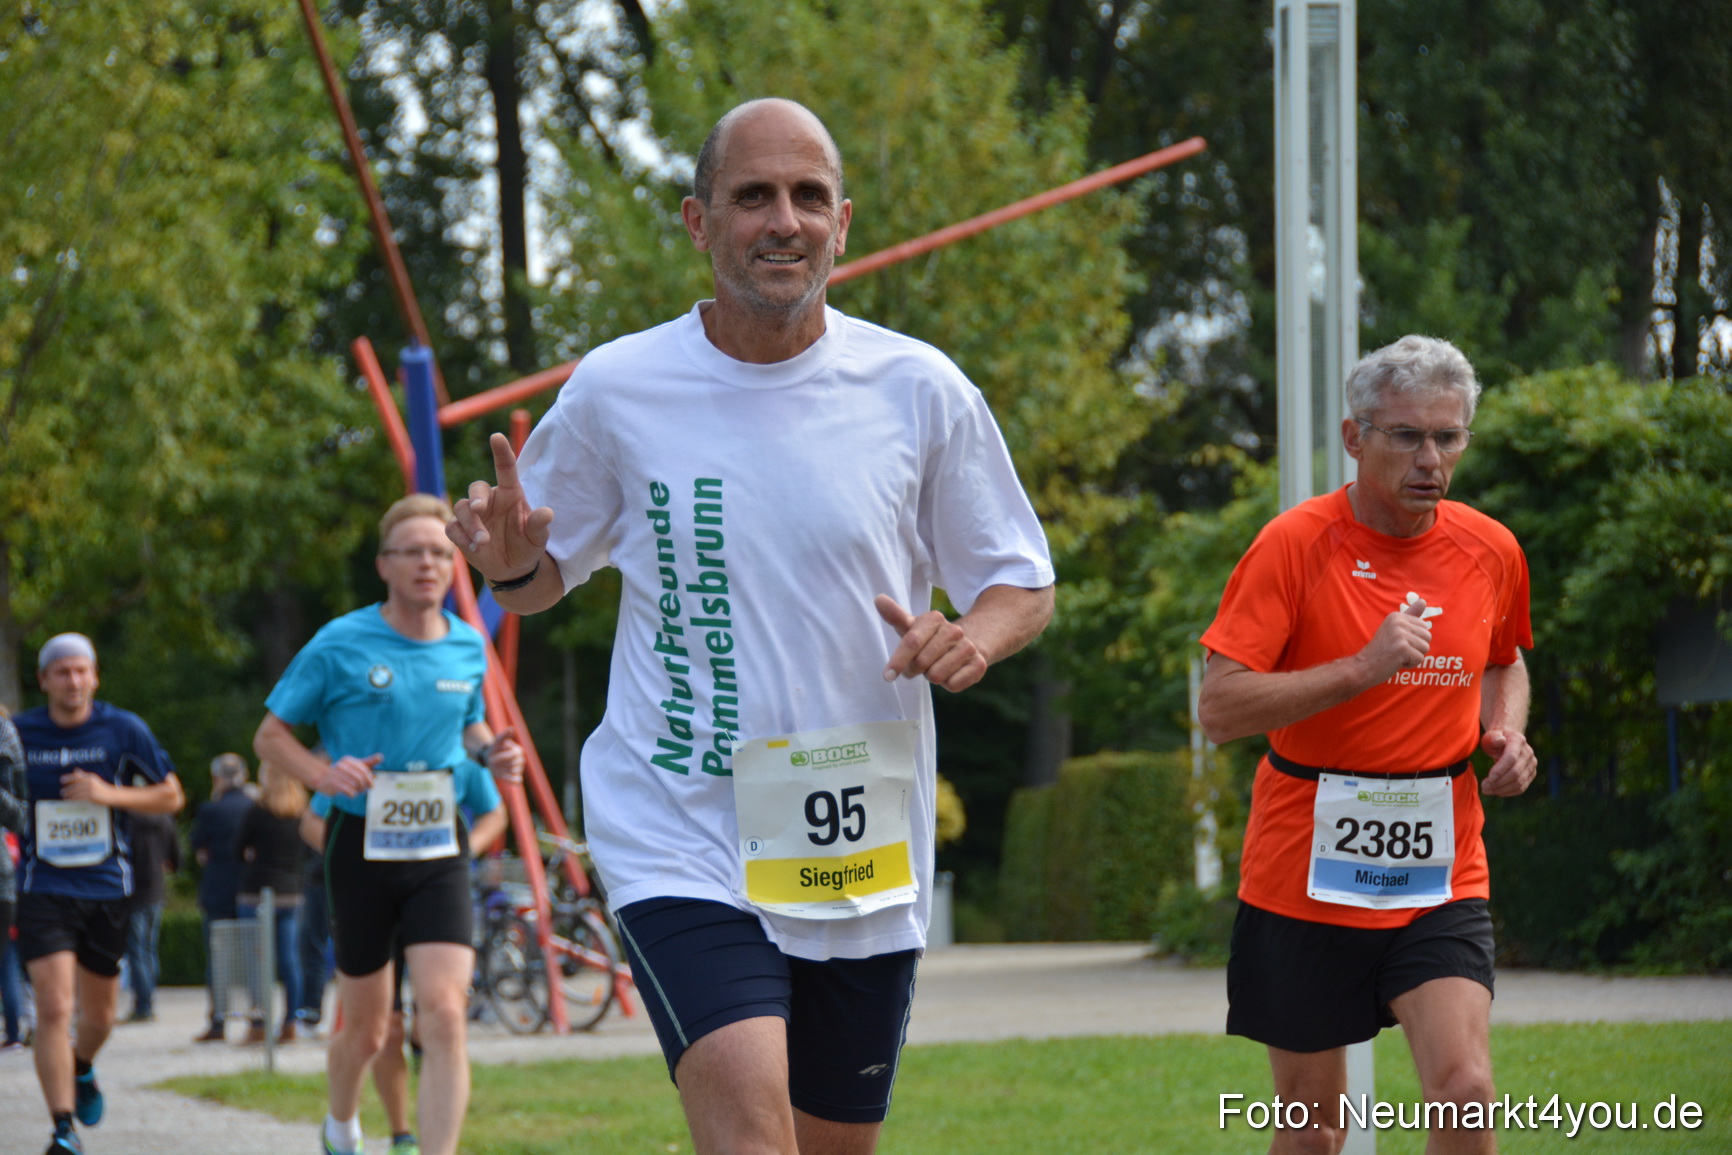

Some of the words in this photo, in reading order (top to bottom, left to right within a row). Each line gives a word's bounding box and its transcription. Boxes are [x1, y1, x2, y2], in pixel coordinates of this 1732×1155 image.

[1352, 570, 1377, 579] erima
[646, 481, 696, 776] NaturFreunde
[684, 477, 739, 777] Pommelsbrunn
[811, 741, 869, 765] BOCK
[1371, 791, 1419, 803] BOCK
[383, 798, 444, 826] 2900
[804, 785, 866, 846] 95
[47, 817, 99, 840] 2590
[1335, 817, 1434, 860] 2385
[750, 841, 758, 851] D
[800, 859, 874, 890] Siegfried
[1355, 869, 1409, 887] Michael
